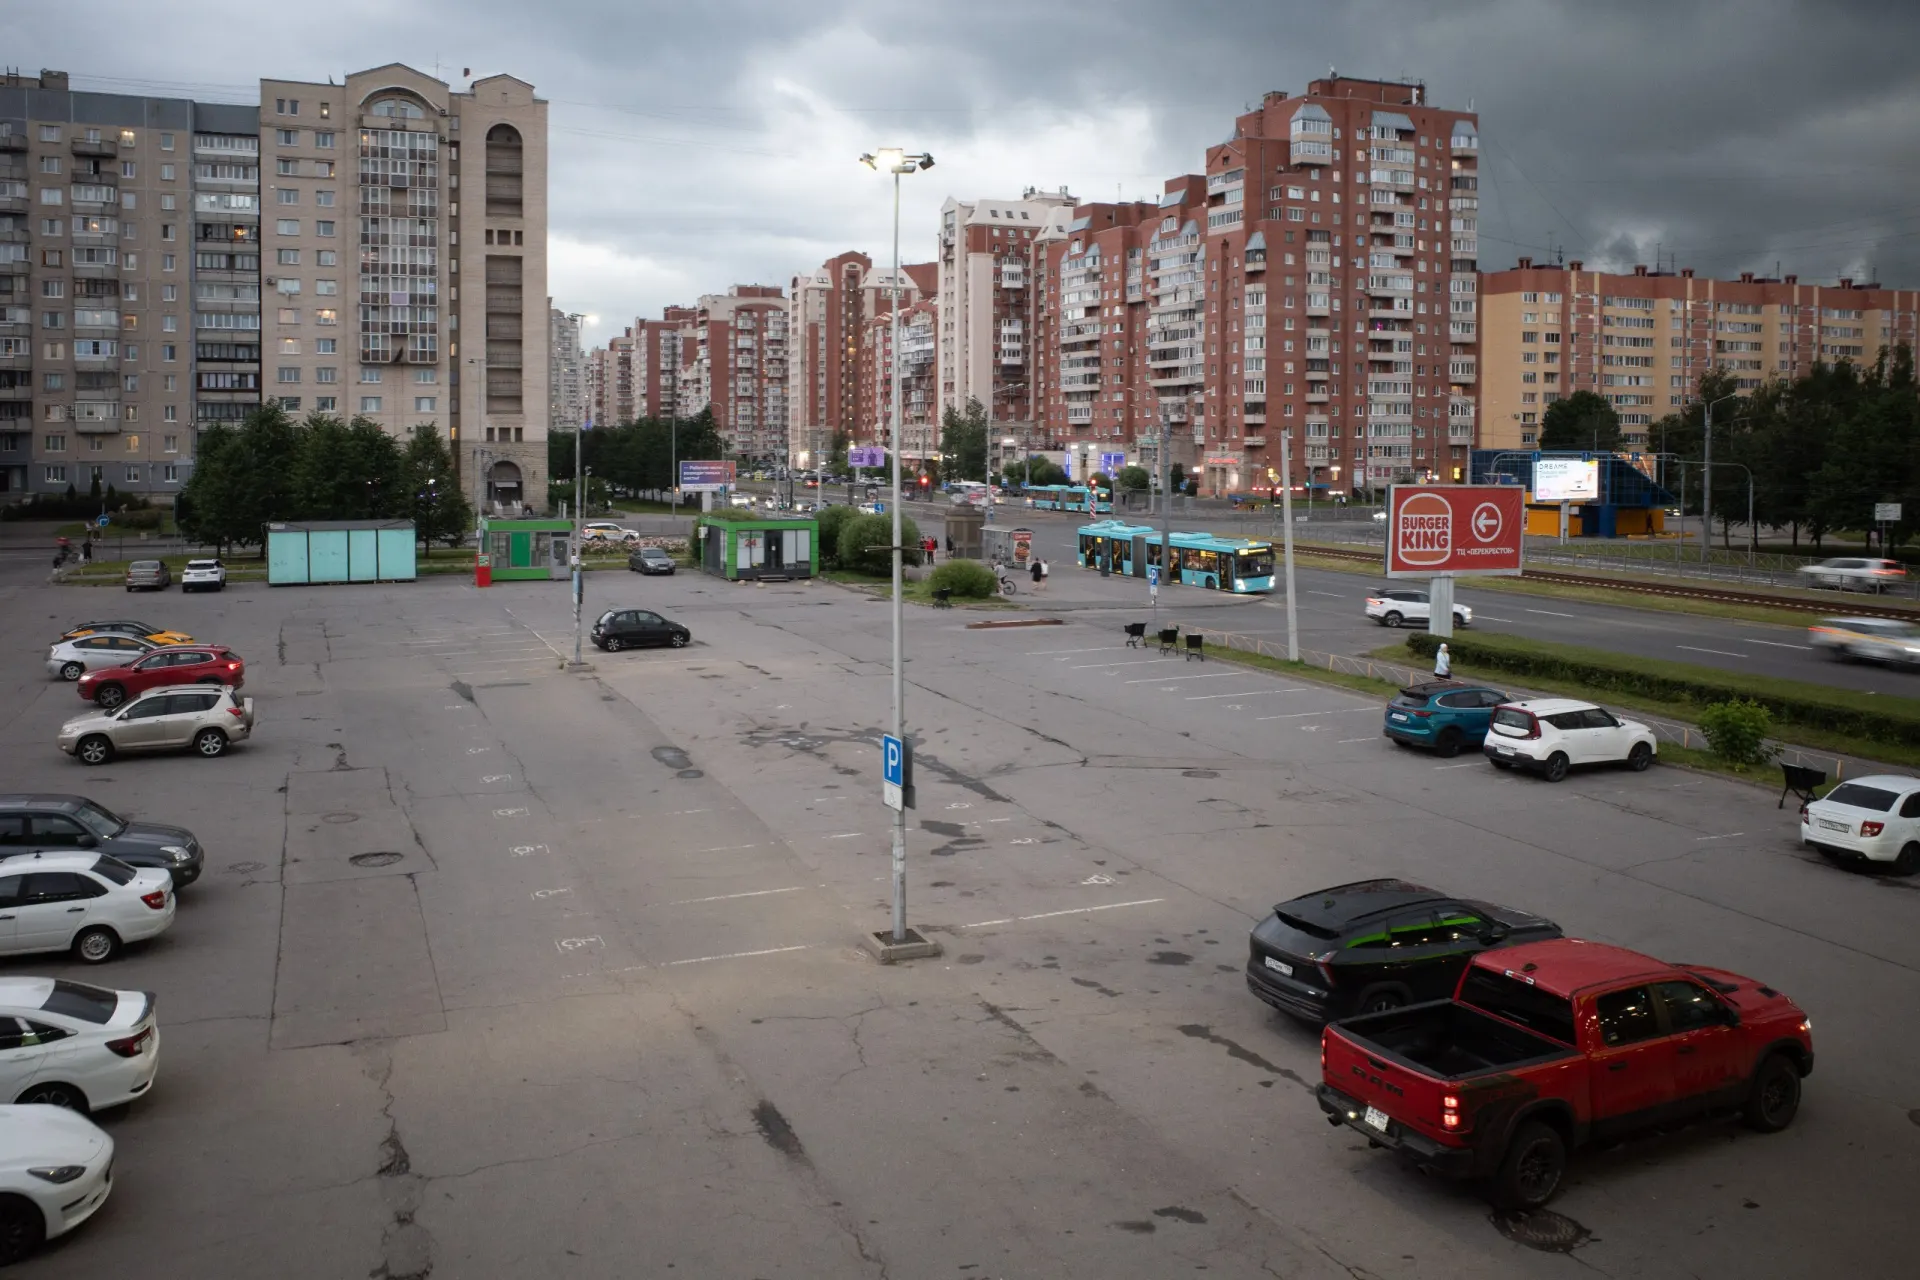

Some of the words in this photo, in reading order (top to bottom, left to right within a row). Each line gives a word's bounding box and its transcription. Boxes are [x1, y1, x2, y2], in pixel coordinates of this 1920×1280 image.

[1402, 516, 1449, 530] BURGER
[1401, 531, 1449, 550] KING
[1456, 548, 1466, 556] ТЦ
[888, 742, 898, 777] P
[1352, 1065, 1403, 1096] RAM
